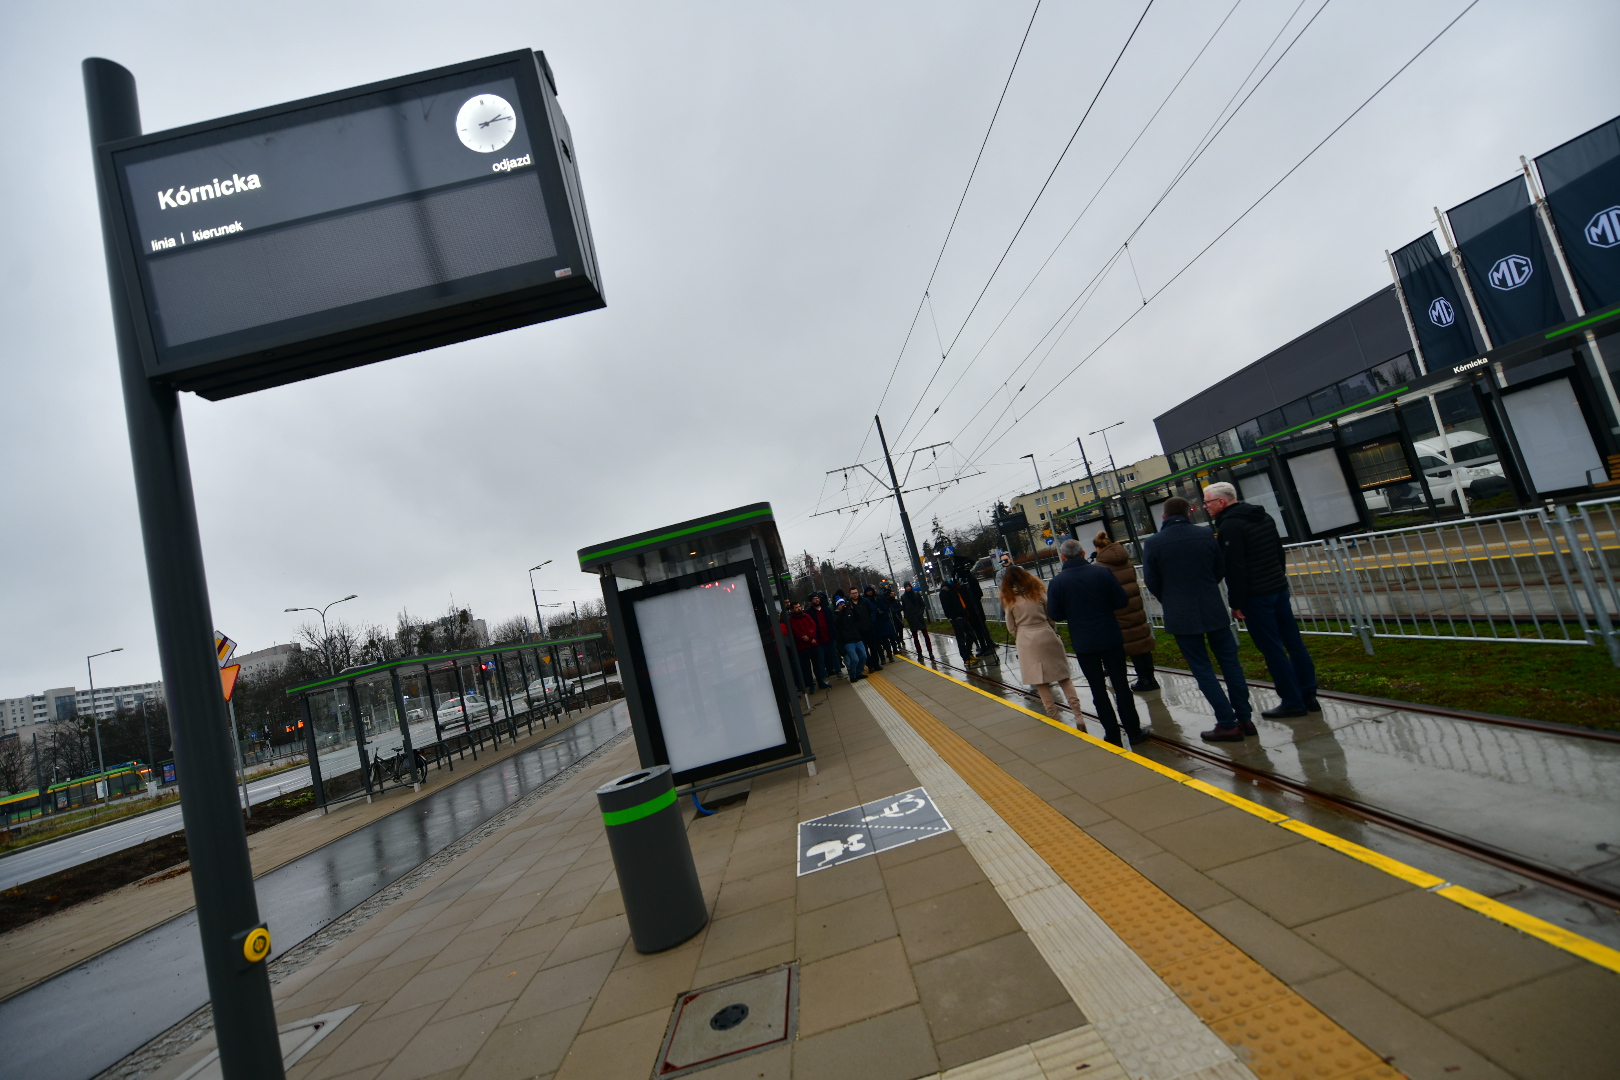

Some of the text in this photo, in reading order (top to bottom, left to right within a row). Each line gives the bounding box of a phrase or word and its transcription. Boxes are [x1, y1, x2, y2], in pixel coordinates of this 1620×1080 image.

[492, 153, 532, 173] odjazd
[157, 173, 262, 210] Kórnicka
[151, 237, 177, 252] linia
[192, 220, 244, 242] kierunek
[1491, 256, 1531, 288] MG
[1430, 299, 1454, 325] MG
[1452, 356, 1489, 374] Kórnicka
